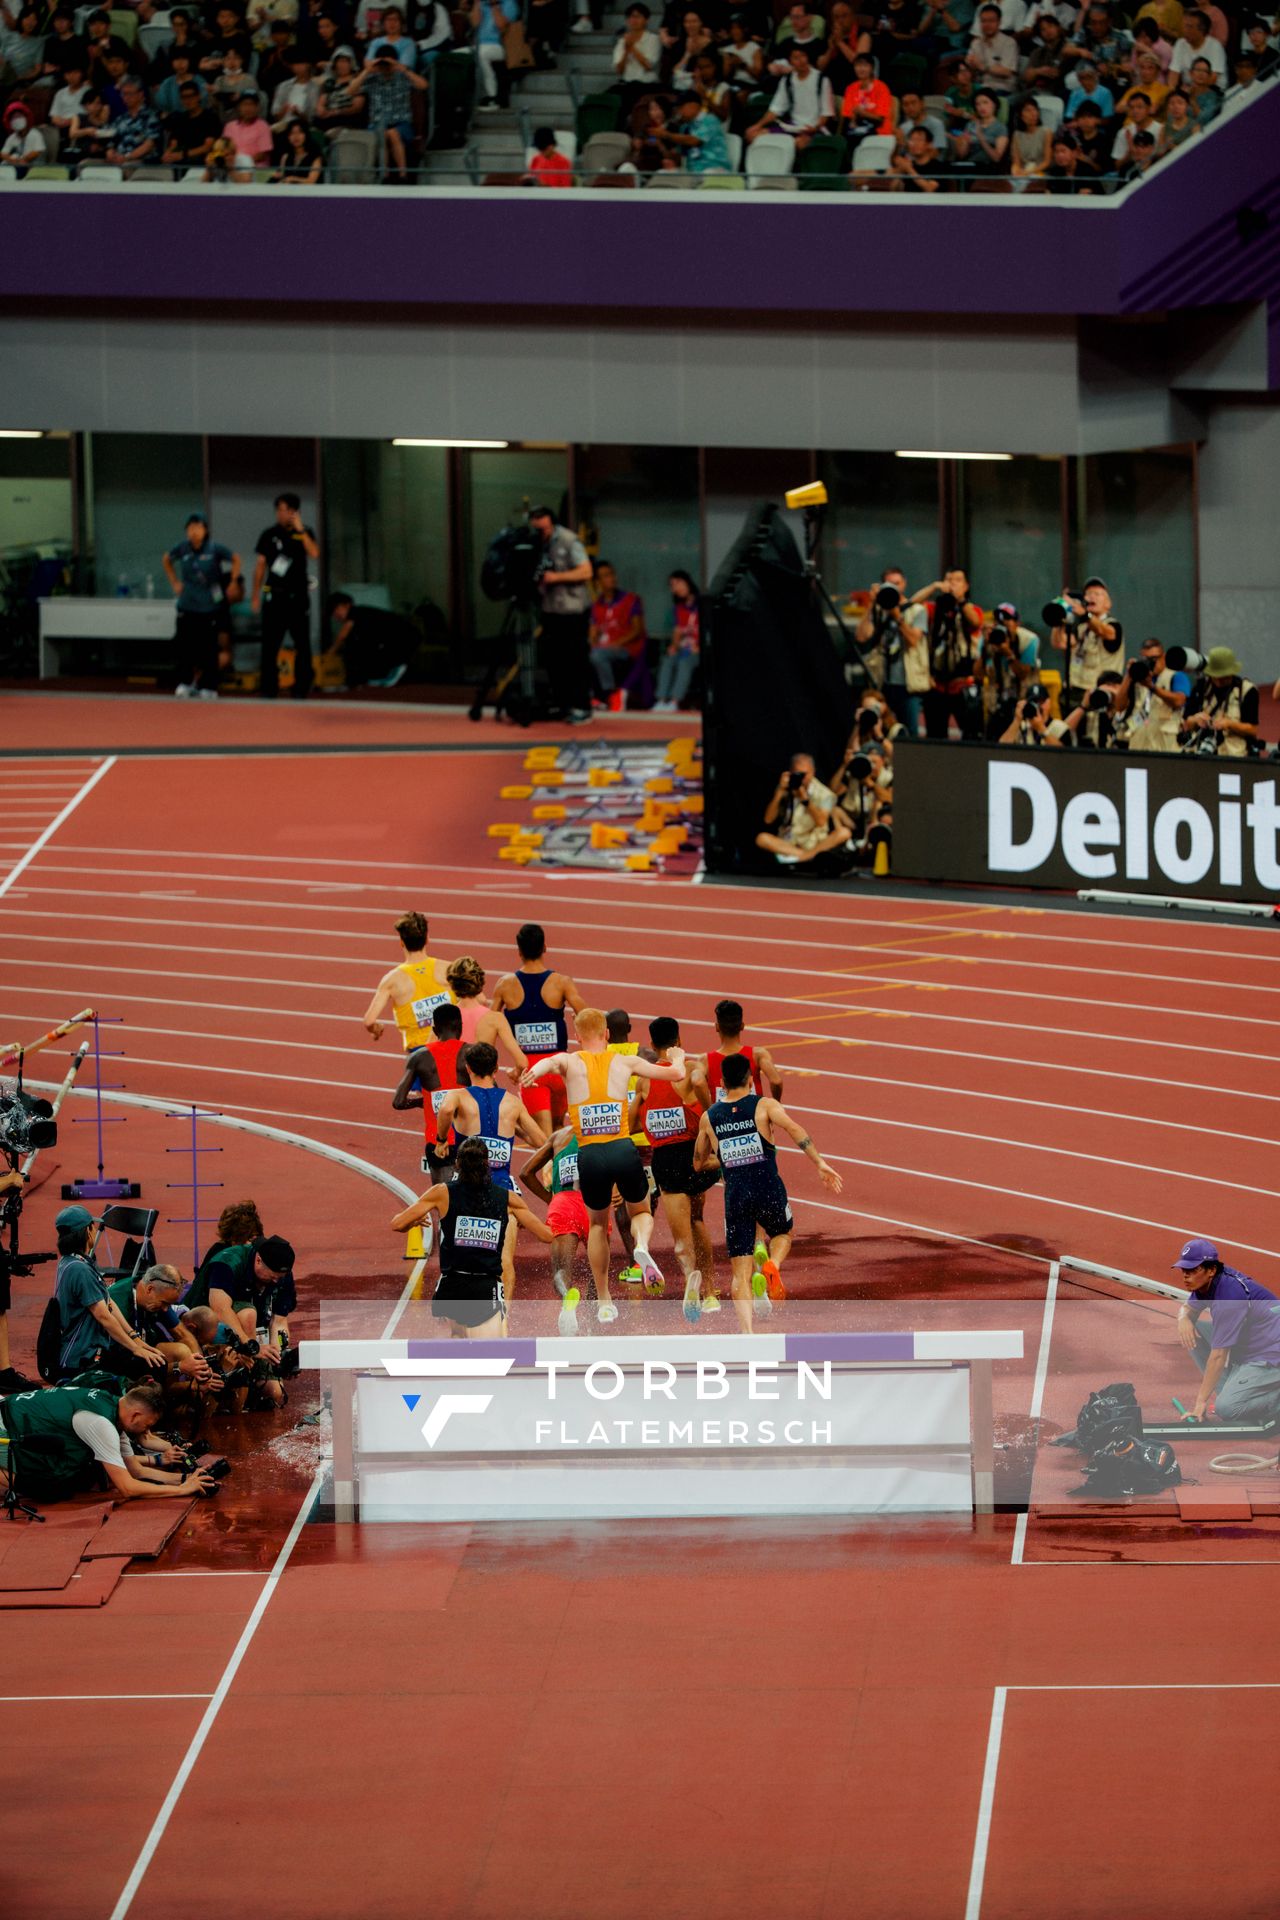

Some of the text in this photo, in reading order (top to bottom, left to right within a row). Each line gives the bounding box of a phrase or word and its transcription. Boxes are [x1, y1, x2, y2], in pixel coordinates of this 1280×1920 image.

[988, 760, 1280, 891] Deloit
[422, 993, 447, 1006] TDK
[526, 1024, 552, 1033] TDK
[518, 1033, 555, 1044] GILAVERT
[591, 1104, 620, 1114] TDK
[654, 1108, 680, 1119] TDK
[582, 1115, 621, 1128] RUPPERT
[715, 1118, 755, 1135] ANDORRA
[730, 1134, 757, 1147] TDK
[722, 1145, 762, 1161] CARABAÑA
[469, 1217, 497, 1230] TDK
[457, 1228, 497, 1241] BEAMISH
